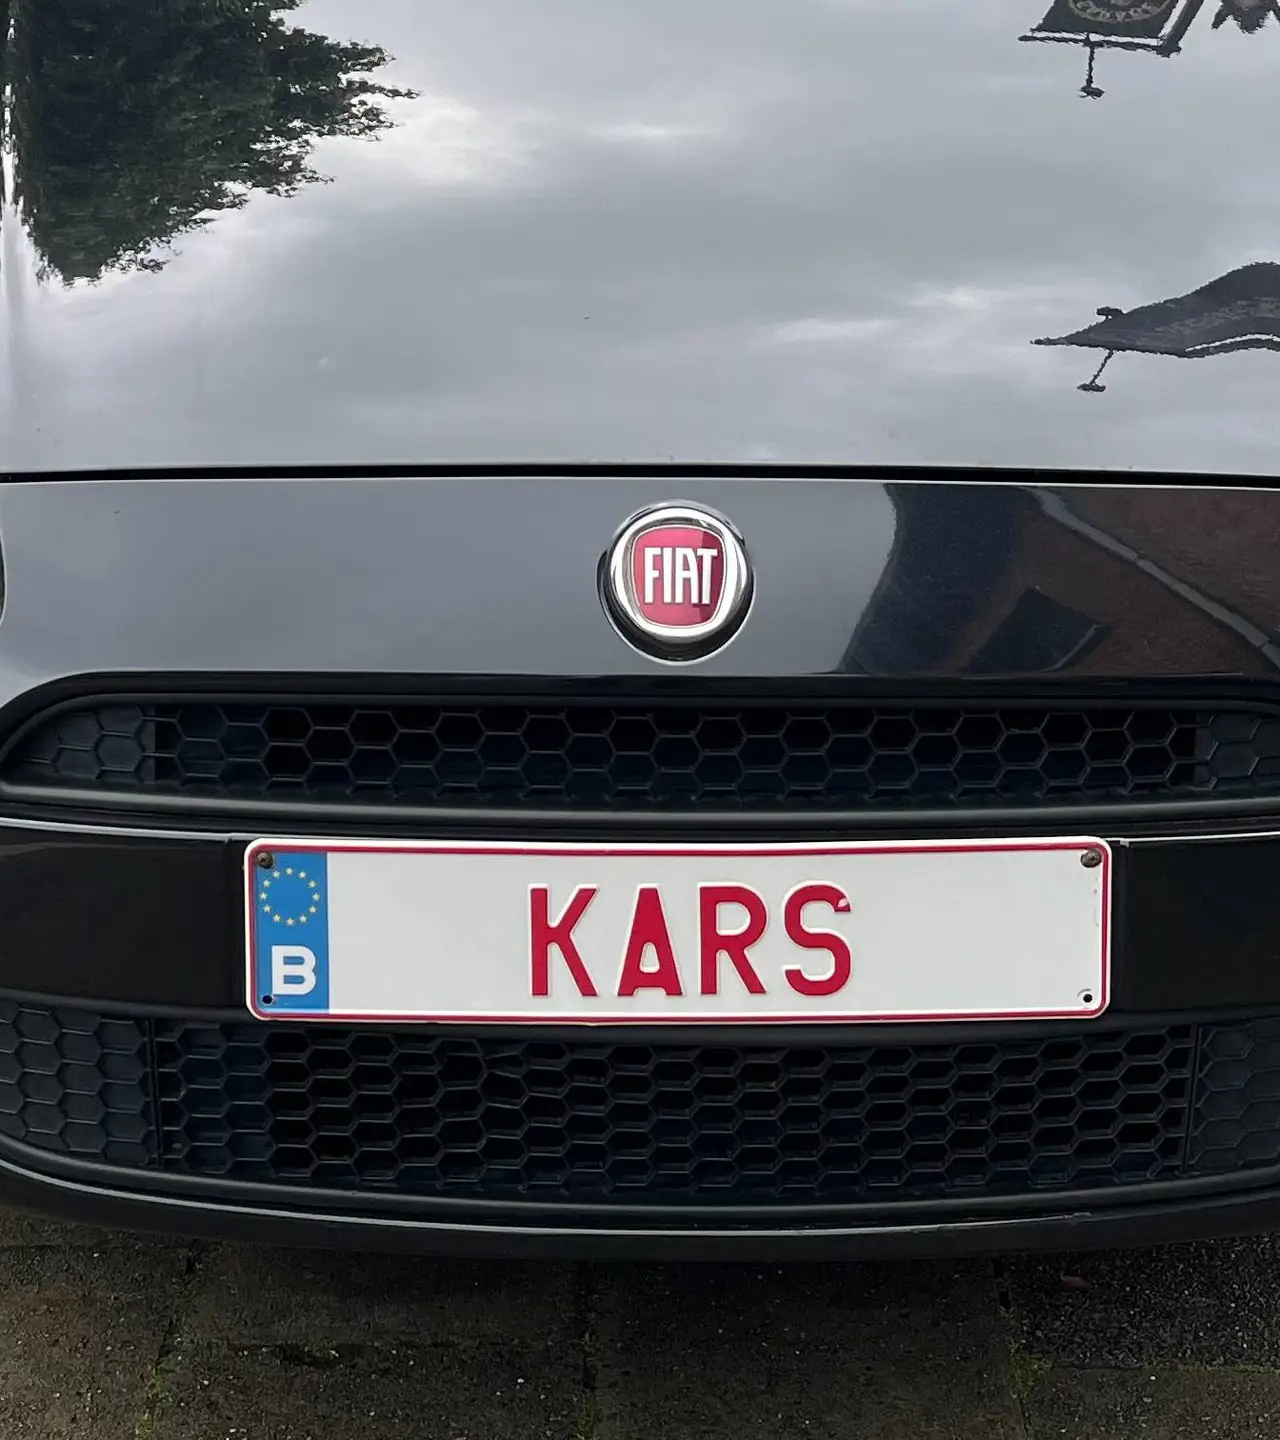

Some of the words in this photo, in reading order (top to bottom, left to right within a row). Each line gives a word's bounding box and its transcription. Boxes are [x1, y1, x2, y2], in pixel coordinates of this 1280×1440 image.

[644, 546, 717, 606] FIAT
[270, 945, 317, 995] B
[528, 883, 852, 998] KARS
